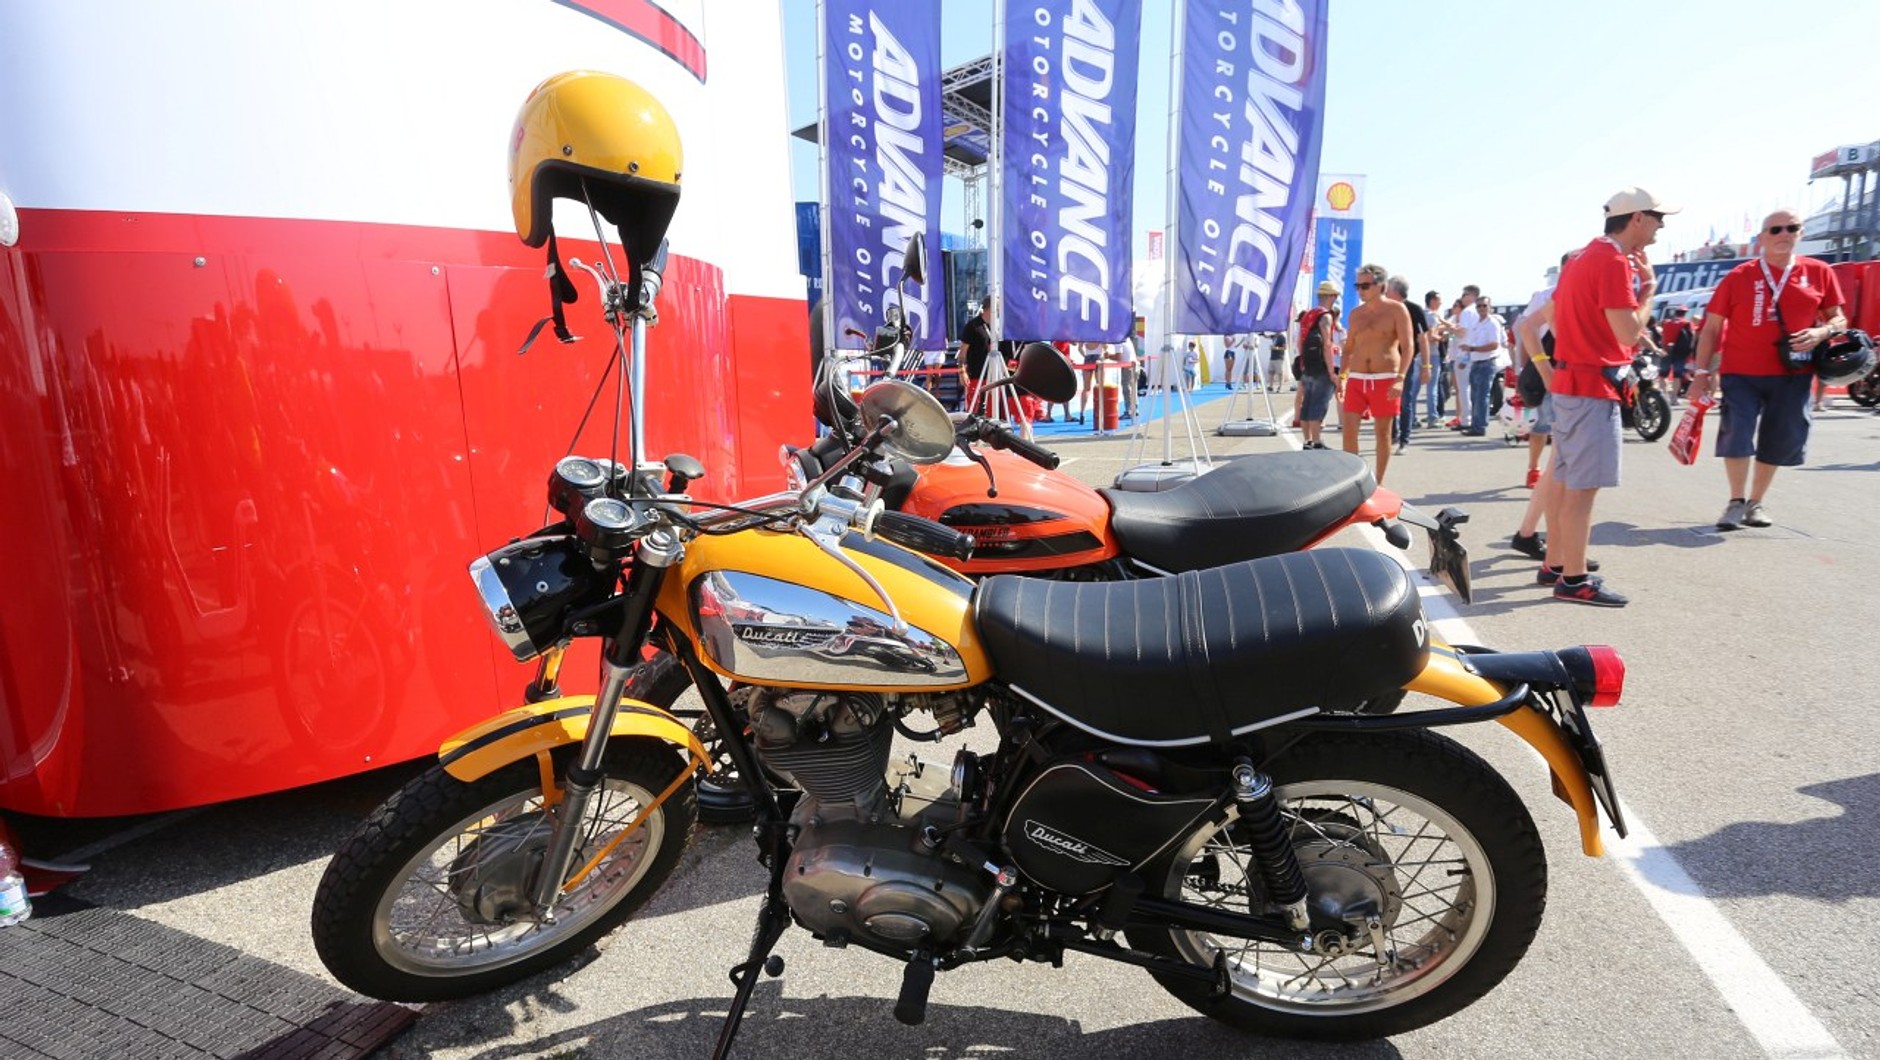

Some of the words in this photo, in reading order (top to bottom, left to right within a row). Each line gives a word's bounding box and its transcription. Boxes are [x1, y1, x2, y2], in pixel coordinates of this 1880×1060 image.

[847, 13, 871, 227] MOTORCYCLE
[869, 9, 929, 339] ADVANCE
[1058, 0, 1114, 331] ADVANCE
[856, 247, 873, 314] OILS
[1030, 230, 1047, 302] OILS
[1197, 218, 1220, 296] OILS
[741, 626, 799, 643] Ducati
[1031, 826, 1088, 854] Ducati
